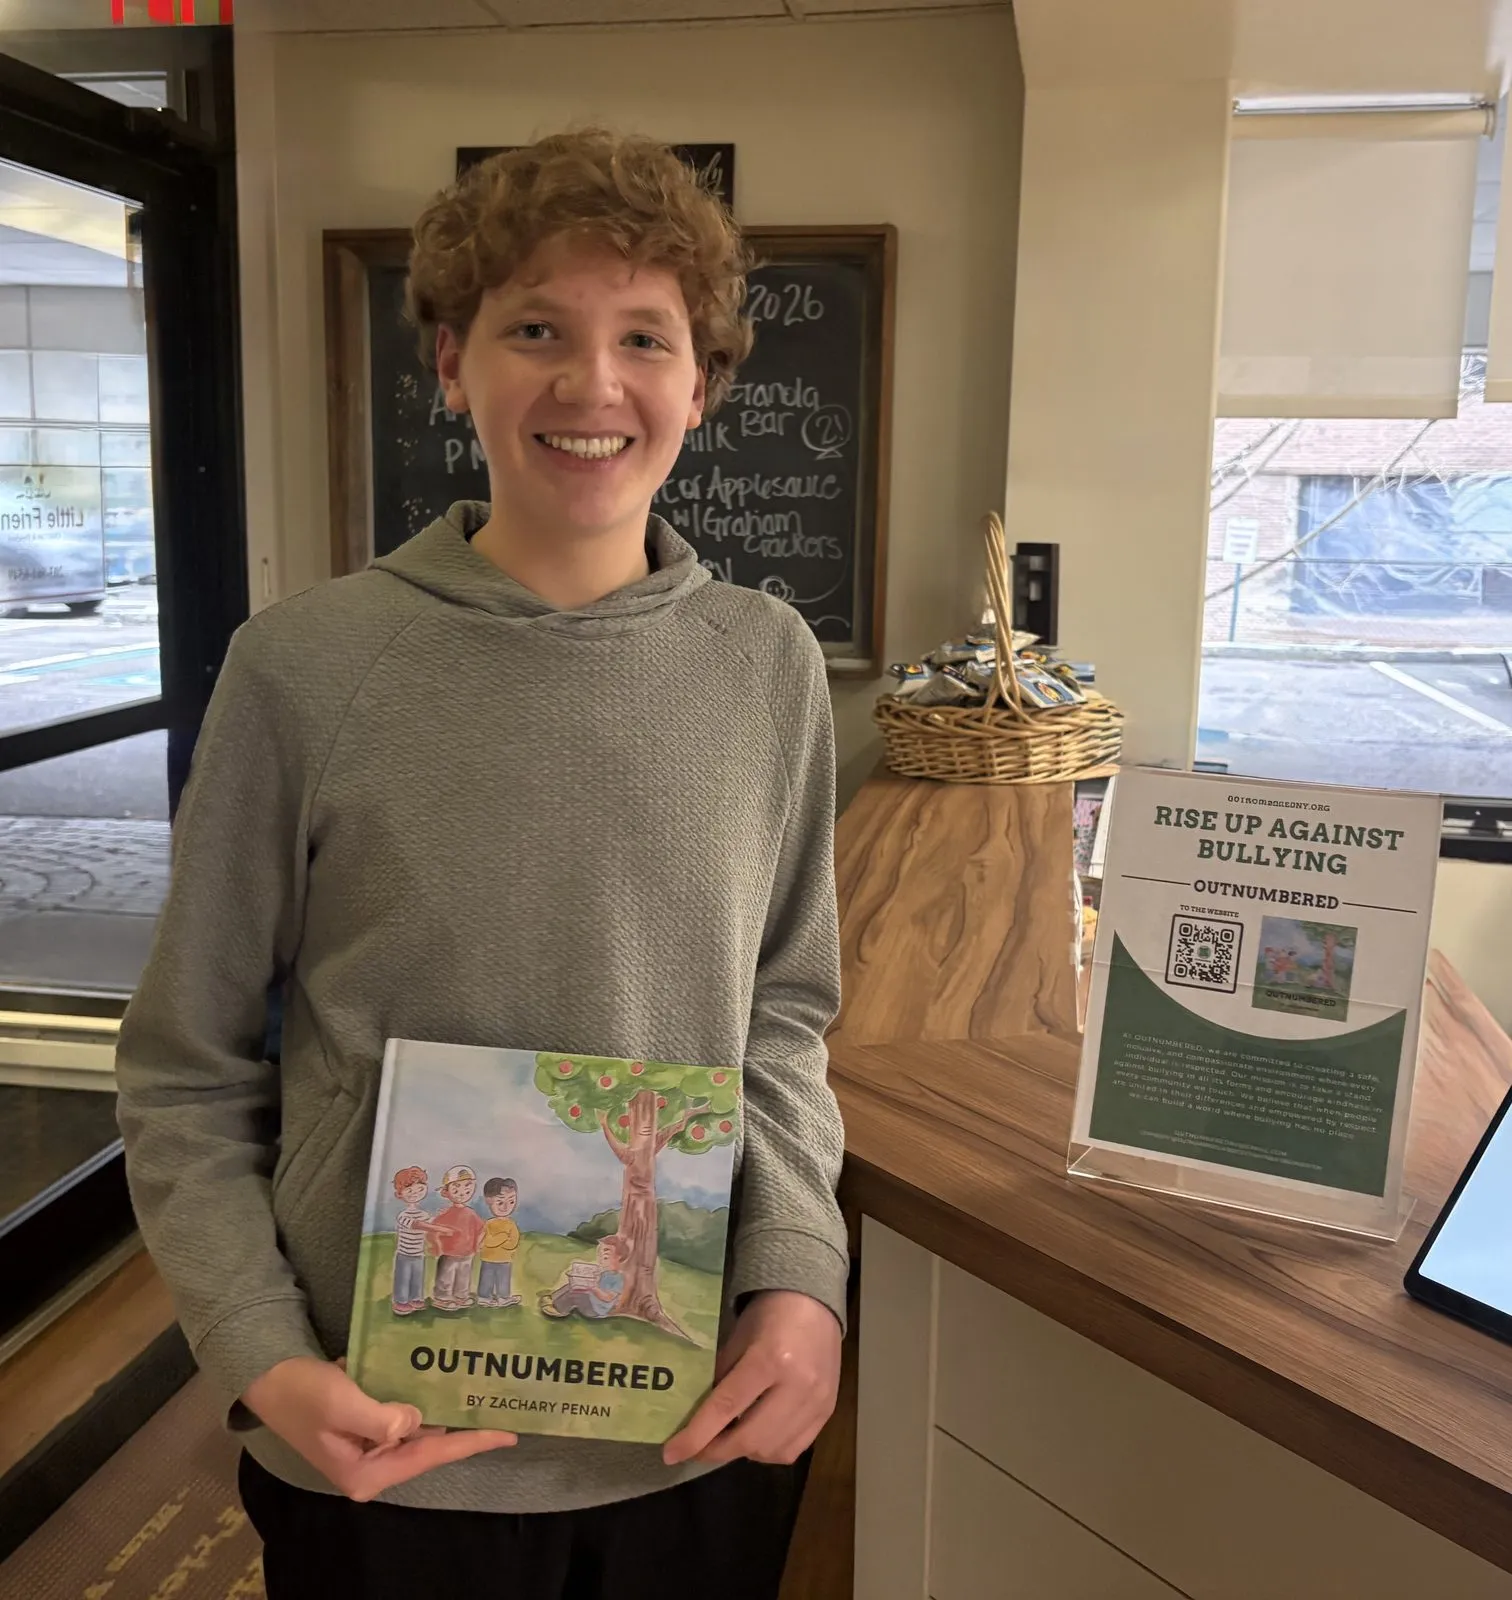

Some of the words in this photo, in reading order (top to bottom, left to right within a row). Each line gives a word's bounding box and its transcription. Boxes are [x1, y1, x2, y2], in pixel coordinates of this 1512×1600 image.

[747, 283, 826, 327] 2026
[739, 410, 795, 437] Bar
[706, 465, 843, 510] Applesauce
[703, 506, 803, 542] Graham
[1154, 805, 1218, 831] RISE
[1224, 812, 1262, 835] UP
[1268, 818, 1404, 851] AGAINST
[1197, 839, 1347, 875] BULLYING
[1180, 904, 1190, 912] TO
[1191, 906, 1206, 914] THE
[1207, 908, 1240, 918] WEBSITE
[1193, 879, 1339, 910] OUTNUMBERED
[410, 1345, 675, 1391] OUTNUMBERED
[466, 1394, 486, 1407] BY
[490, 1396, 558, 1413] ZACHARY
[561, 1402, 612, 1418] PENAN
